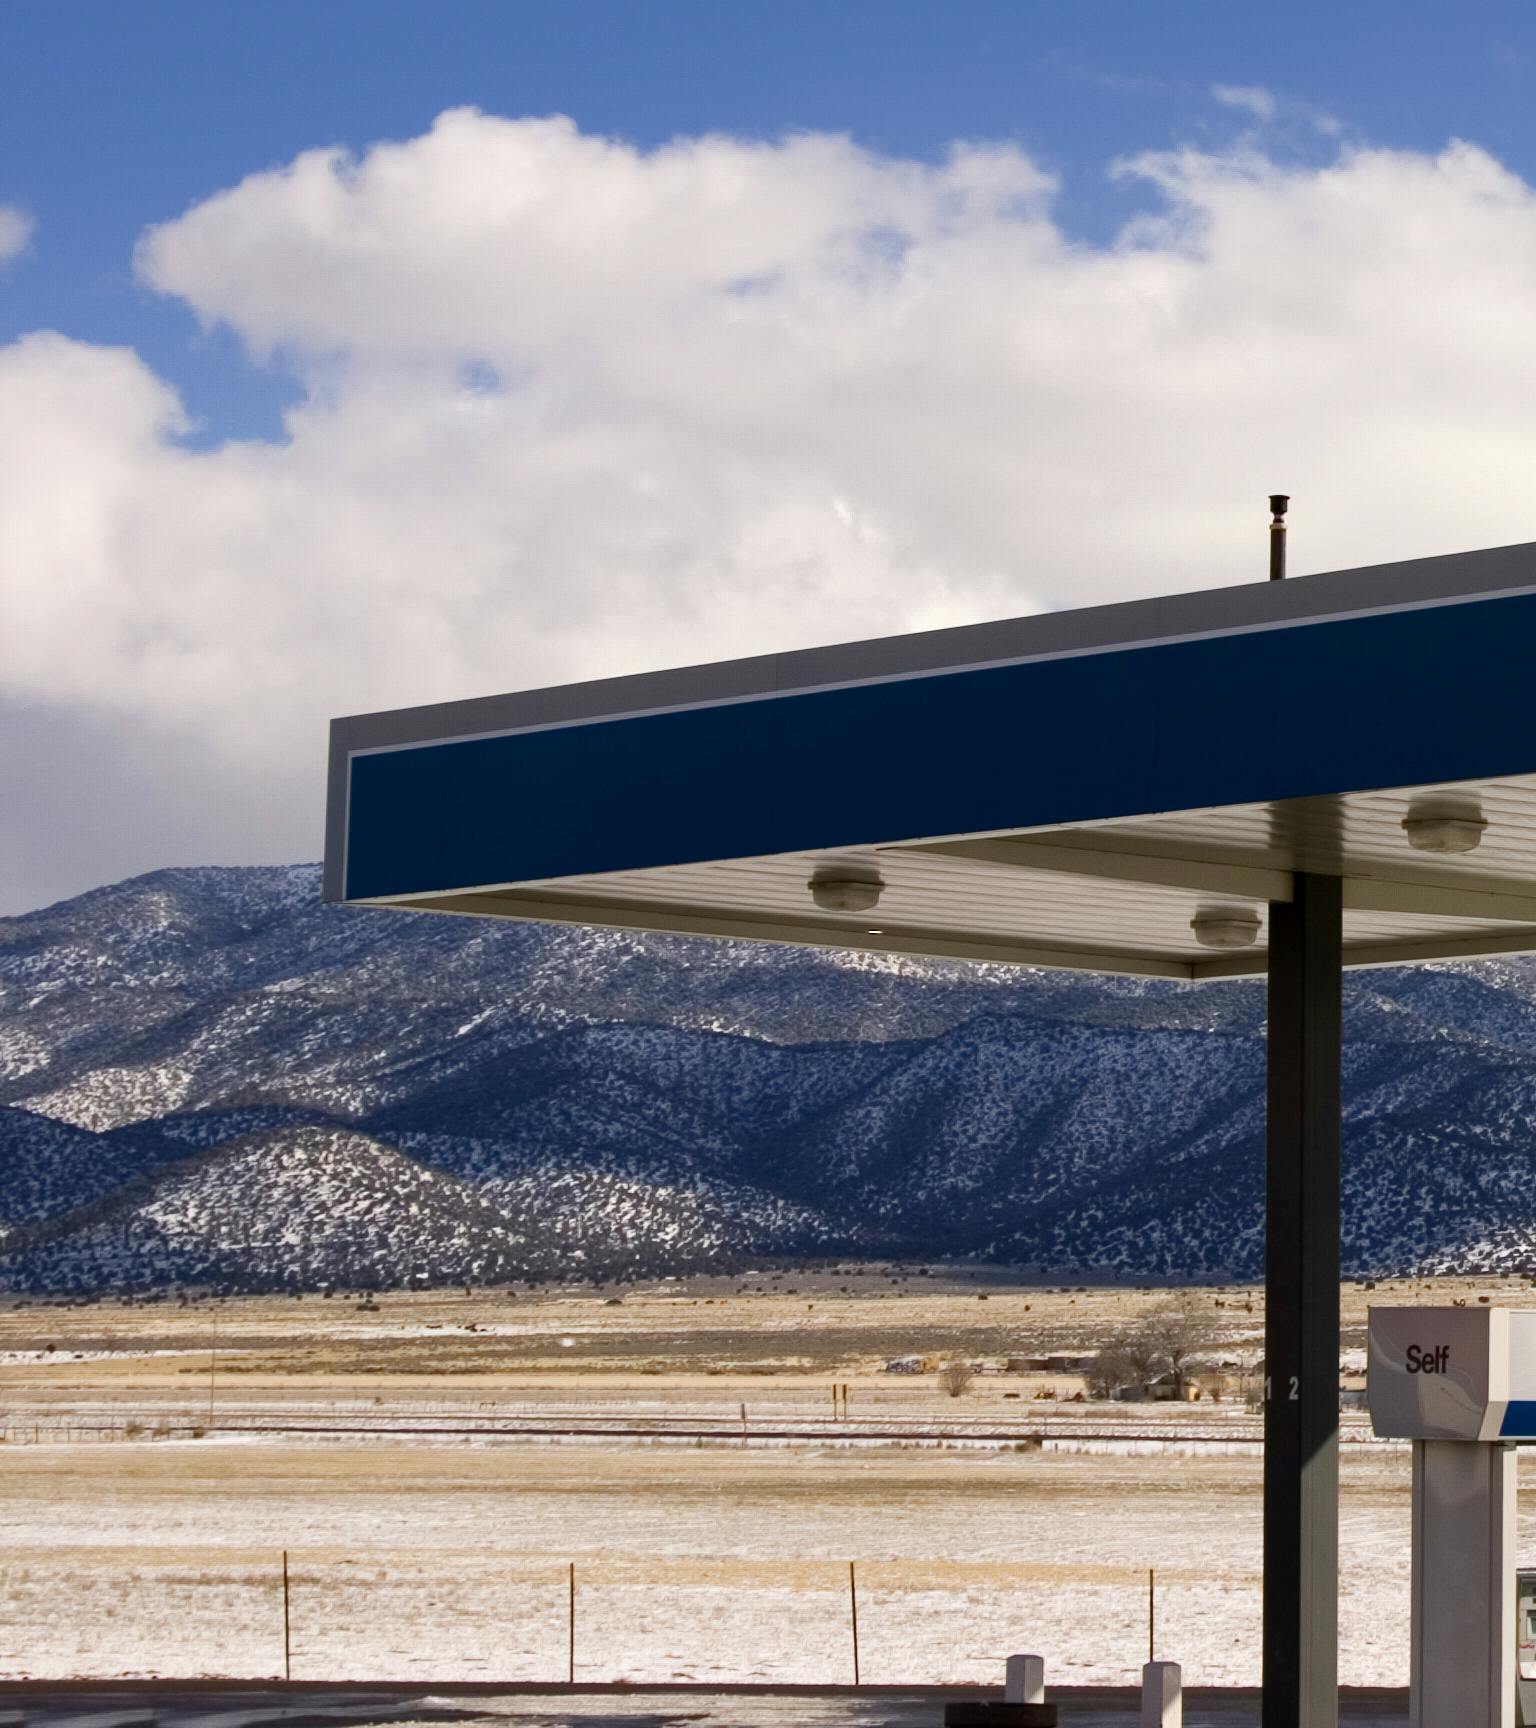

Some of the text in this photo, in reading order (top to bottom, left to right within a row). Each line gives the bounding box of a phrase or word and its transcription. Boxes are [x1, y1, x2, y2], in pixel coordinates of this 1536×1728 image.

[1406, 1344, 1450, 1374] Self
[1265, 1376, 1299, 1400] 1 2
